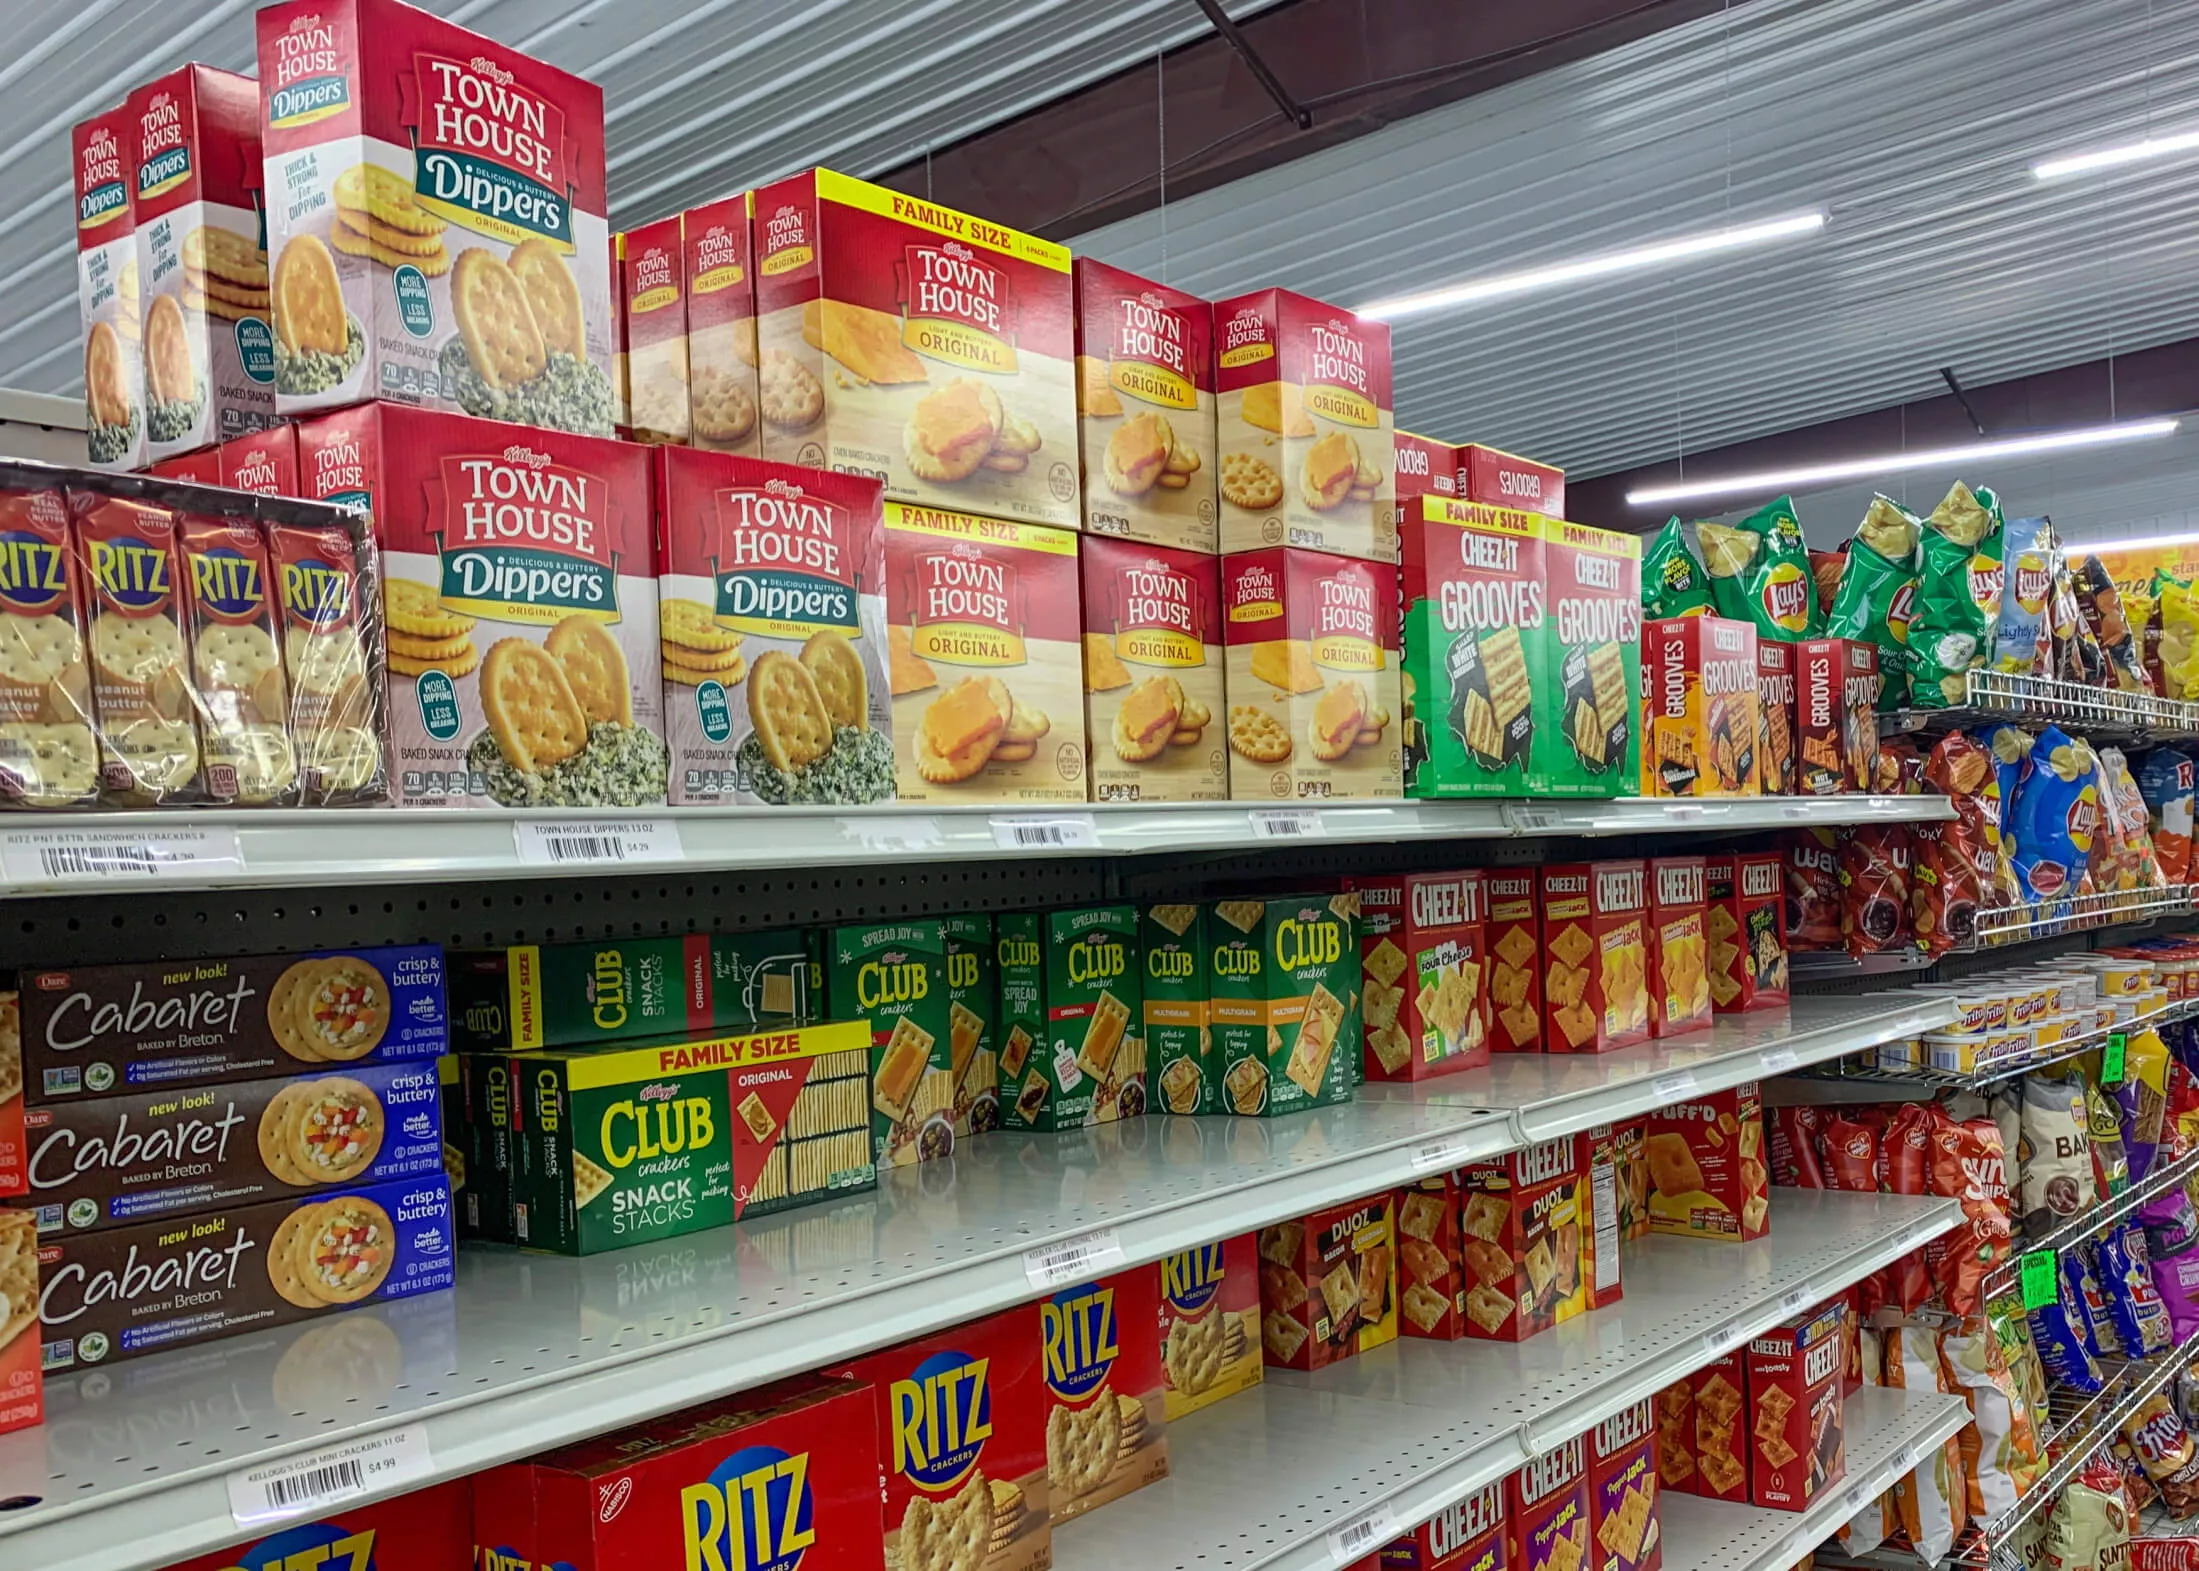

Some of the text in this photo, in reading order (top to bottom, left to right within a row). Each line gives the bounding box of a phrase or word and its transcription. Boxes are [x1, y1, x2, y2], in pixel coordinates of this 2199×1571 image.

[432, 62, 545, 139] TOWN
[434, 103, 552, 182] HOUSE
[140, 151, 185, 188] Dippers
[289, 192, 326, 221] DIPPING
[426, 155, 560, 231] Dippers
[893, 196, 1012, 250] FAMILY SIZE
[917, 251, 995, 299] TOWN
[920, 281, 1000, 332] HOUSE
[1121, 300, 1180, 343] TOWN
[920, 333, 1001, 366] ORIGINAL
[1312, 327, 1363, 365] TOWN
[1122, 372, 1184, 402] ORIGINAL
[1314, 353, 1367, 392] HOUSE
[460, 461, 588, 513] TOWN
[463, 503, 595, 556] HOUSE
[731, 493, 833, 539] TOWN
[902, 508, 1019, 542] FAMILY SIZE
[1445, 501, 1529, 532] FAMILY SIZE
[733, 529, 840, 576] HOUSE
[1563, 525, 1629, 552] FAMILY SIZE
[87, 541, 170, 594] RITZ
[189, 553, 263, 602] RITZ
[453, 553, 603, 605] Dippers
[725, 575, 847, 619] Dippers
[1125, 570, 1187, 600] TOWN
[1770, 579, 1805, 617] Lay's
[928, 587, 1008, 626] HOUSE
[1128, 598, 1191, 632] HOUSE
[1441, 581, 1542, 632] GROOVES
[1558, 597, 1638, 644] GROOVES
[769, 622, 812, 634] ORIGINAL
[928, 637, 1009, 660] ORIGINAL
[1129, 642, 1192, 661] ORIGINAL
[1321, 647, 1374, 666] ORIGINAL
[424, 679, 446, 692] MORE
[1666, 639, 1685, 719] GROOVES
[1704, 659, 1755, 695] GROOVES
[1811, 658, 1829, 728] GROOVES
[1845, 674, 1878, 703] GROOVES
[423, 690, 452, 703] DIPPING
[431, 707, 451, 721] LESS
[708, 713, 724, 724] LESS
[401, 749, 453, 760] BAKED SNACK
[408, 774, 419, 783] 70
[535, 825, 561, 834] TOWN
[563, 825, 591, 834] HOUSE
[595, 824, 629, 833] DIPPERS
[2071, 801, 2095, 836] Lay
[148, 832, 198, 841] CRACKERS
[862, 927, 912, 947] SPREAD JOY
[1072, 912, 1111, 929] SPREAD JOY
[1214, 947, 1261, 975] CLUB
[1276, 918, 1340, 972] CLUB
[1421, 946, 1472, 972] FOUR Cheese
[163, 964, 227, 985] new look!
[393, 971, 441, 987] buttery
[398, 956, 439, 973] crisp &
[1068, 943, 1125, 983] CLUB
[642, 956, 654, 1017] SNACK
[857, 961, 928, 1008] CLUB
[1004, 988, 1037, 1000] SPREAD
[46, 975, 256, 1050] Cabaret
[880, 1003, 914, 1016] crackers
[1013, 1000, 1028, 1014] JOY
[1219, 1007, 1256, 1016] MULTIGRAIN
[137, 1033, 223, 1051] BAKED BY Breton
[659, 1034, 801, 1072] FAMILY SIZE
[387, 1088, 435, 1104] buttery
[392, 1073, 434, 1090] crisp &
[149, 1092, 215, 1117] new look!
[28, 1101, 246, 1189] Cabaret
[600, 1096, 715, 1169] CLUB
[2056, 1134, 2088, 1158] BAK
[122, 1162, 212, 1185] BAKED BY Breton
[638, 1154, 691, 1178] crackers
[704, 1160, 730, 1179] perfect
[1472, 1170, 1498, 1181] DUOZ
[403, 1187, 446, 1206] crisp &
[612, 1178, 693, 1212] SNACK
[701, 1185, 728, 1202] packing
[1533, 1186, 1563, 1220] DUOZ
[397, 1203, 447, 1221] buttery
[612, 1199, 695, 1235] STACKS
[1332, 1206, 1371, 1244] DUOZ
[158, 1218, 226, 1247] new look!
[38, 1227, 256, 1325] Cabaret
[1185, 1286, 1213, 1301] CRACKERS
[1042, 1287, 1119, 1384] RITZ
[1069, 1367, 1104, 1385] CRACKERS
[890, 1357, 994, 1474] RITZ
[294, 1457, 317, 1470] CLUB
[319, 1452, 338, 1463] MINI
[339, 1440, 382, 1458] CRACKERS
[395, 1434, 406, 1444] OZ
[931, 1449, 973, 1474] CRACKERS
[602, 1477, 632, 1520] NABISCO
[681, 1452, 816, 1571] RITZ
